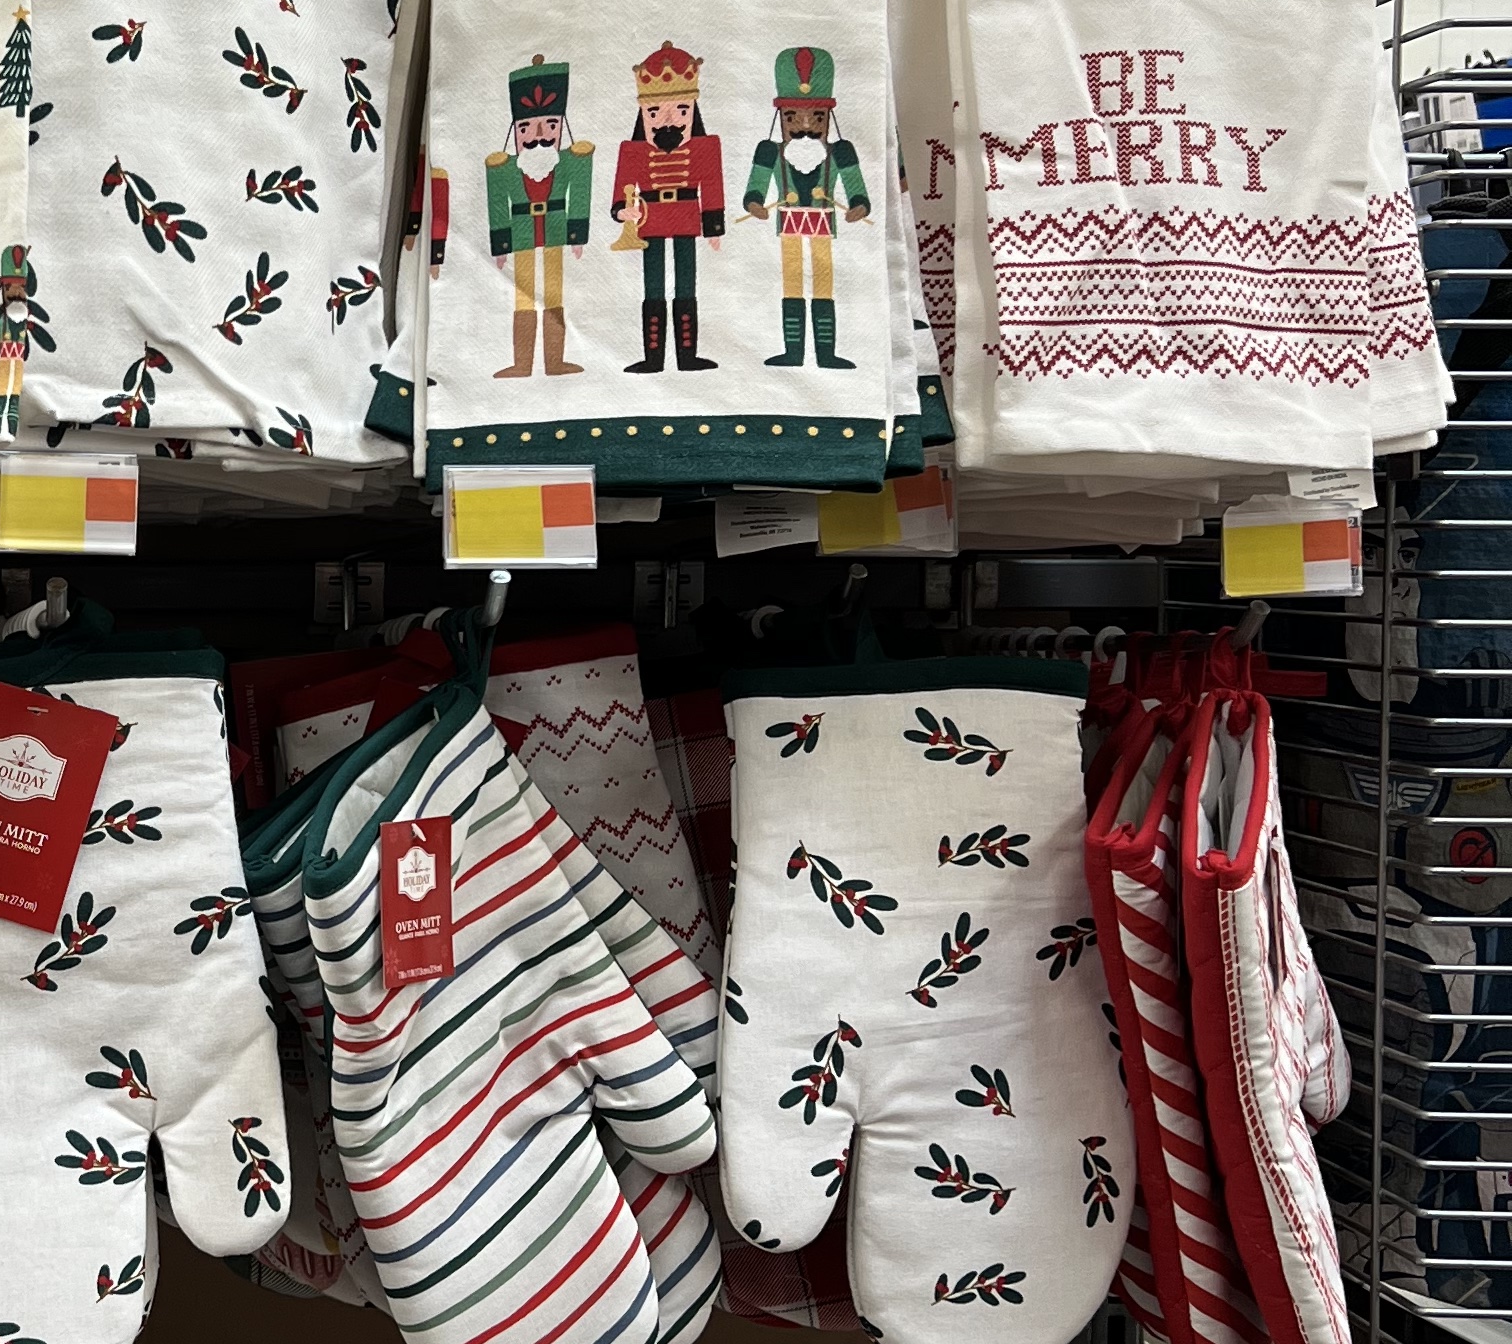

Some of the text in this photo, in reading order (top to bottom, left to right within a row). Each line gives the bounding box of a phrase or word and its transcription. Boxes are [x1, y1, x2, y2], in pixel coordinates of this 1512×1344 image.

[1080, 49, 1186, 117] BE
[979, 118, 1287, 192] MERRY
[0, 779, 29, 794] TIME
[5, 823, 48, 847] MITT
[11, 840, 41, 854] HORNO
[403, 874, 431, 887] HOLIDAY
[395, 919, 419, 934] OVEN
[421, 915, 441, 930] MITT
